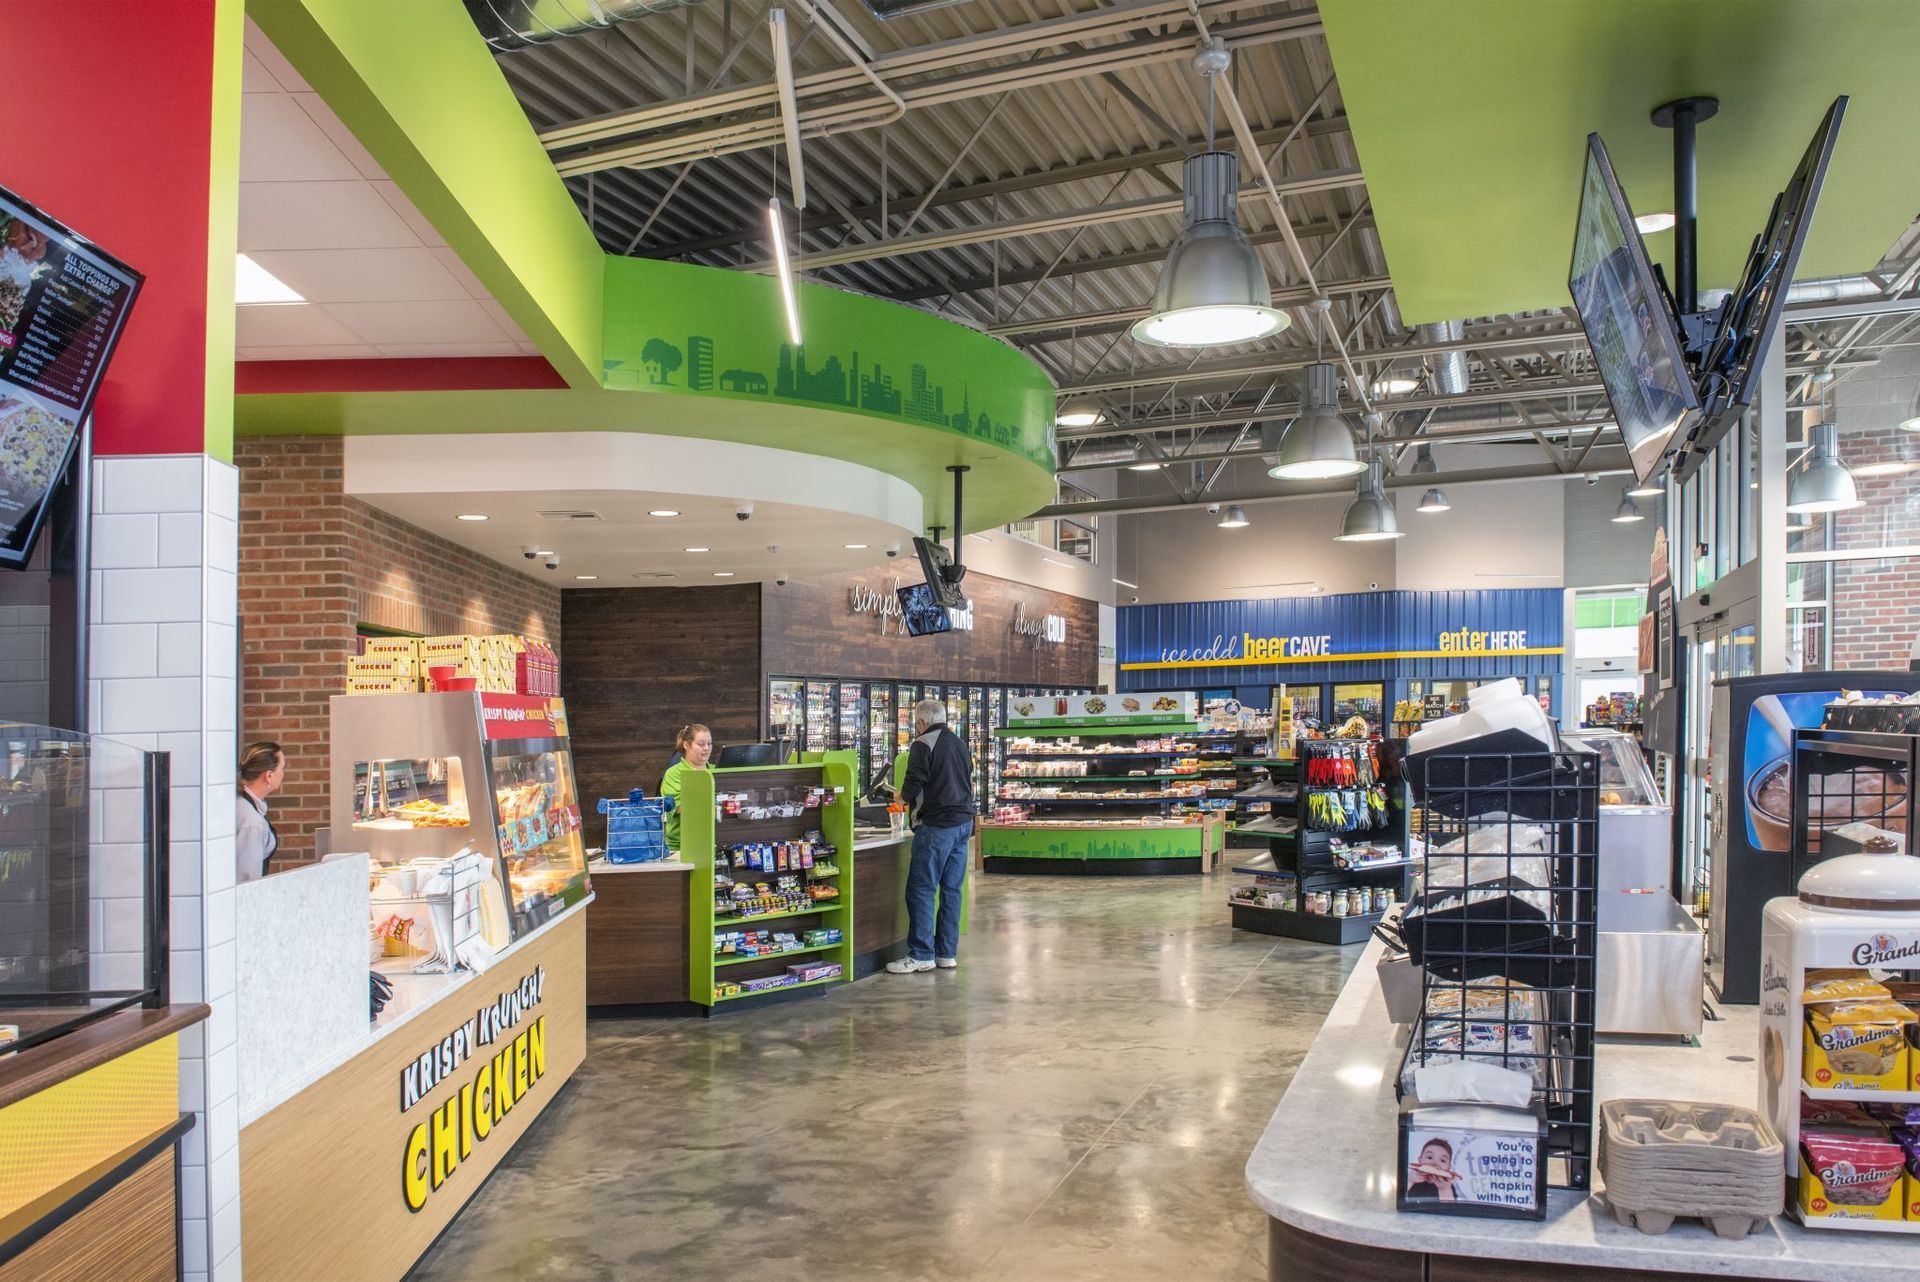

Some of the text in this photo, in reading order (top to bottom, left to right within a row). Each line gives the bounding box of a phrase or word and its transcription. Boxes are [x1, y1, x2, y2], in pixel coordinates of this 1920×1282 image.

[64, 263, 86, 281] EXTRA
[65, 253, 120, 290] ALL TOPPINGS NO
[1015, 602, 1066, 650] always COLD
[427, 643, 462, 651] CHICKEN
[1161, 632, 1331, 663] ice cold beer CAVE
[1440, 626, 1527, 651] enter HERE
[1852, 940, 1920, 966] Grand
[401, 964, 546, 1113] KRISPY KRUNCHY
[1822, 1027, 1901, 1051] Grandma's
[402, 1015, 545, 1214] CHICKEN
[1496, 1141, 1533, 1152] You're
[1482, 1155, 1533, 1167] going to
[1490, 1168, 1521, 1178] need
[1490, 1181, 1532, 1192] napkin
[1477, 1193, 1533, 1205] with that.
